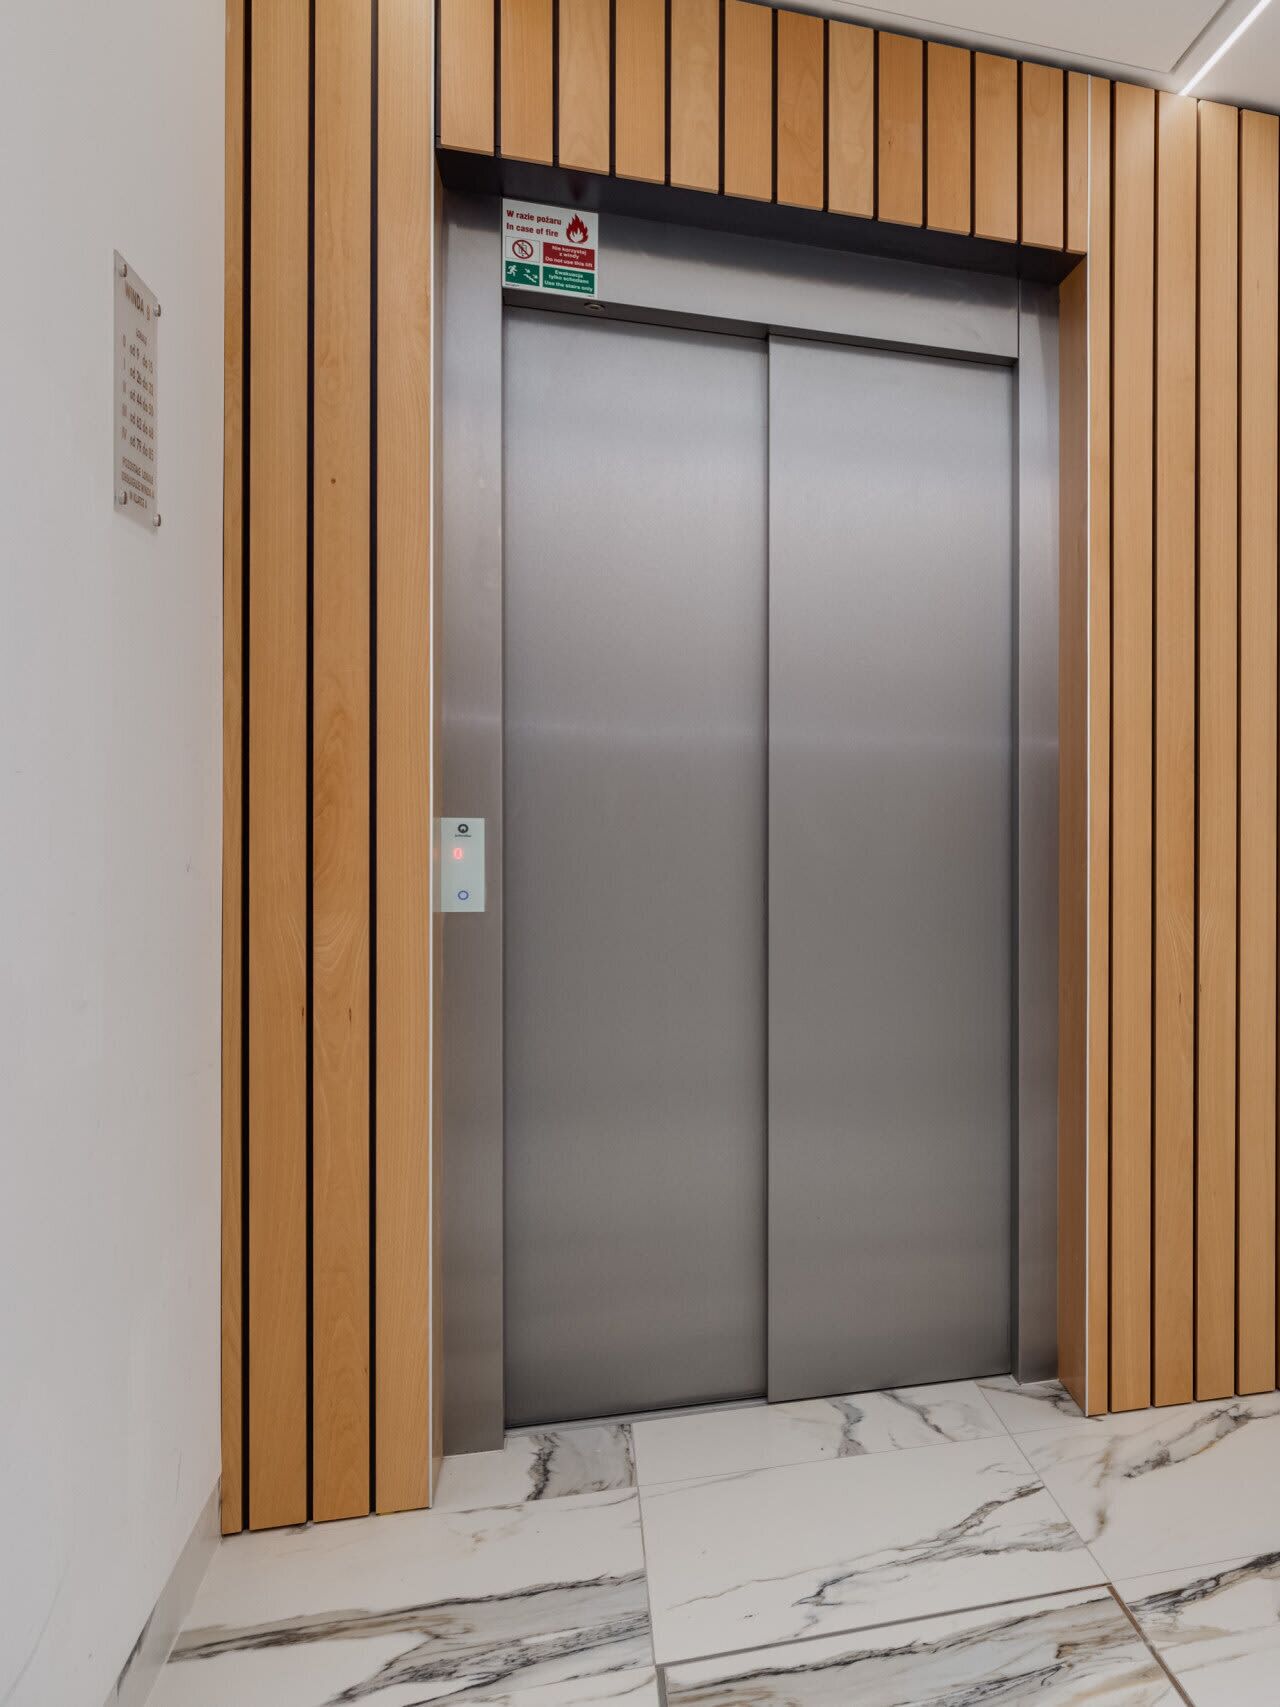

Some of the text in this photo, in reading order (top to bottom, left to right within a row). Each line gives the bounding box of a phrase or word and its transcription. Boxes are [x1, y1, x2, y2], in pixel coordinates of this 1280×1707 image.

[506, 209, 562, 226] W razie pożaru
[506, 222, 559, 238] In case of fire
[562, 247, 587, 255] korzystaj
[554, 269, 584, 279] Ewakuacja
[563, 276, 589, 284] schodami
